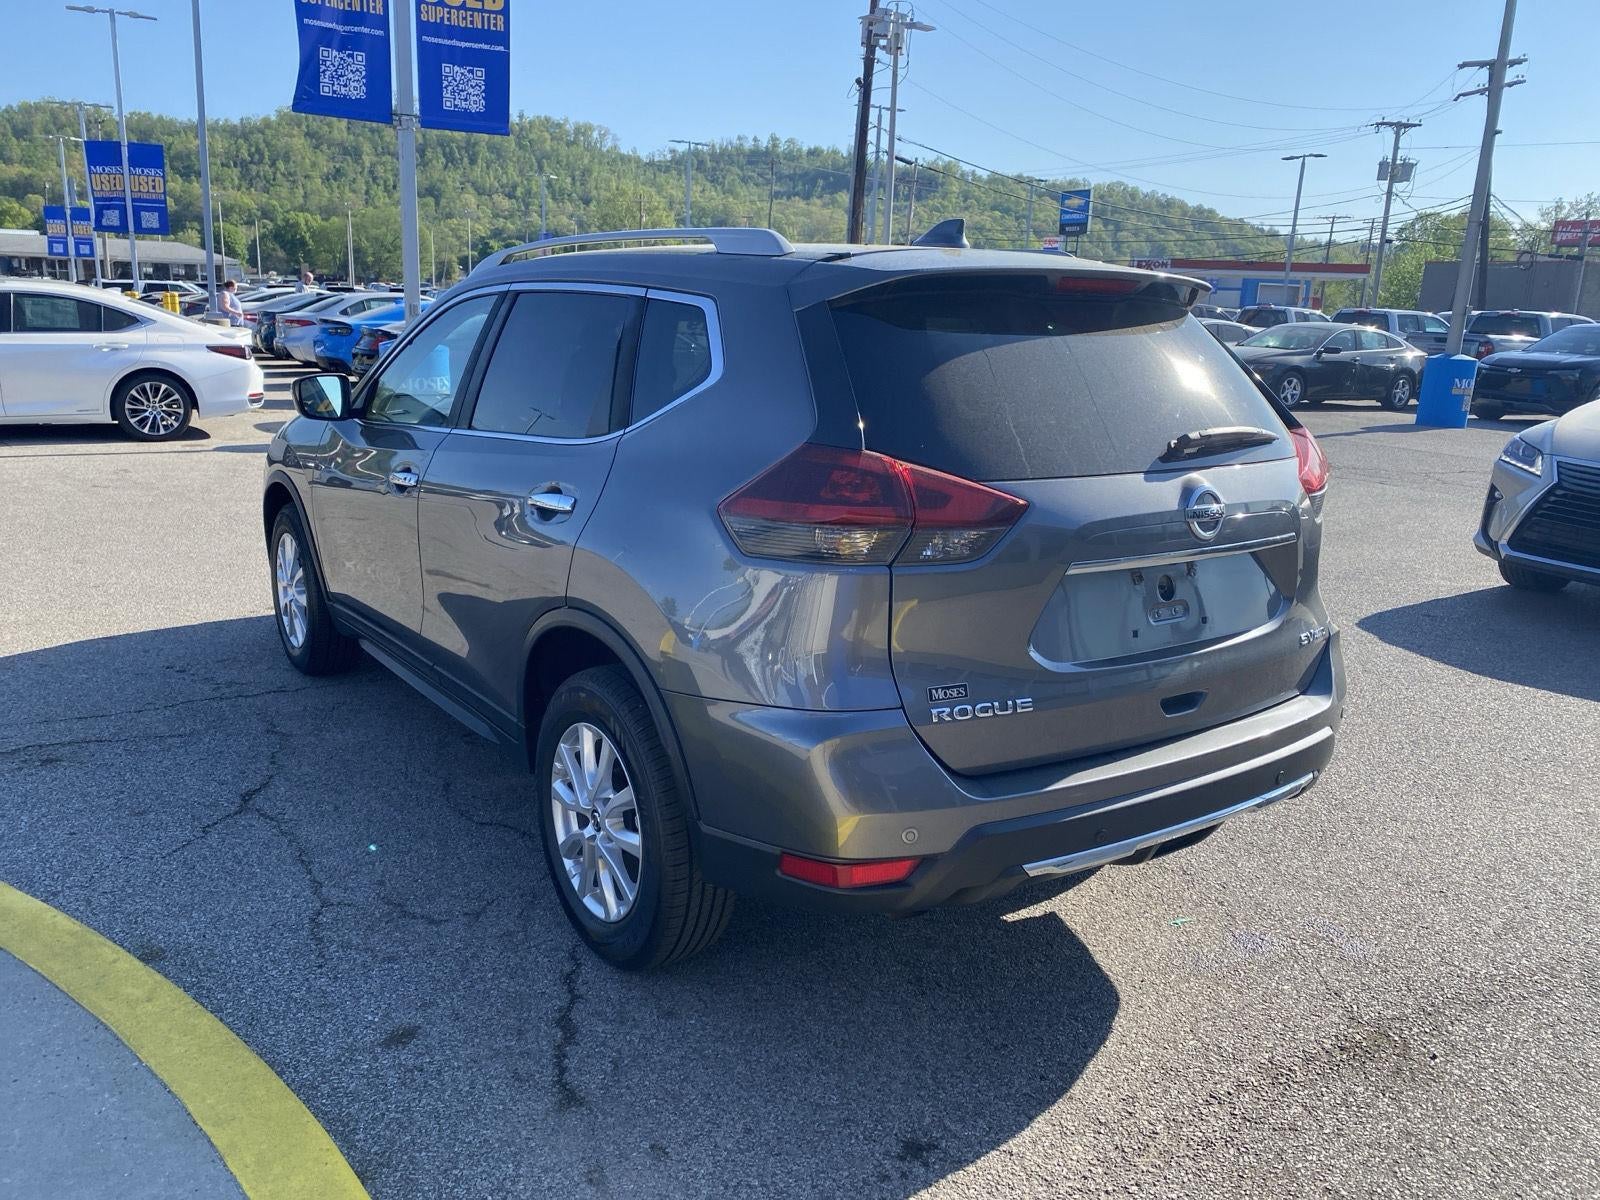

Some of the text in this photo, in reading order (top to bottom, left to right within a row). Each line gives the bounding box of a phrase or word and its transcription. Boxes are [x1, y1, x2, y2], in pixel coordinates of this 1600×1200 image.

[300, 0, 384, 16] RCENTER
[420, 4, 504, 32] SUPERCENTER
[303, 18, 385, 37] mosesusedsupercenter.com
[421, 35, 505, 52] mosesusedsupercenter.com
[90, 165, 123, 174] MOSES
[130, 166, 163, 176] MOSES
[92, 173, 125, 191] USED
[130, 174, 164, 194] USED
[1136, 260, 1169, 270] EXXON
[930, 698, 1034, 723] ROGUE
